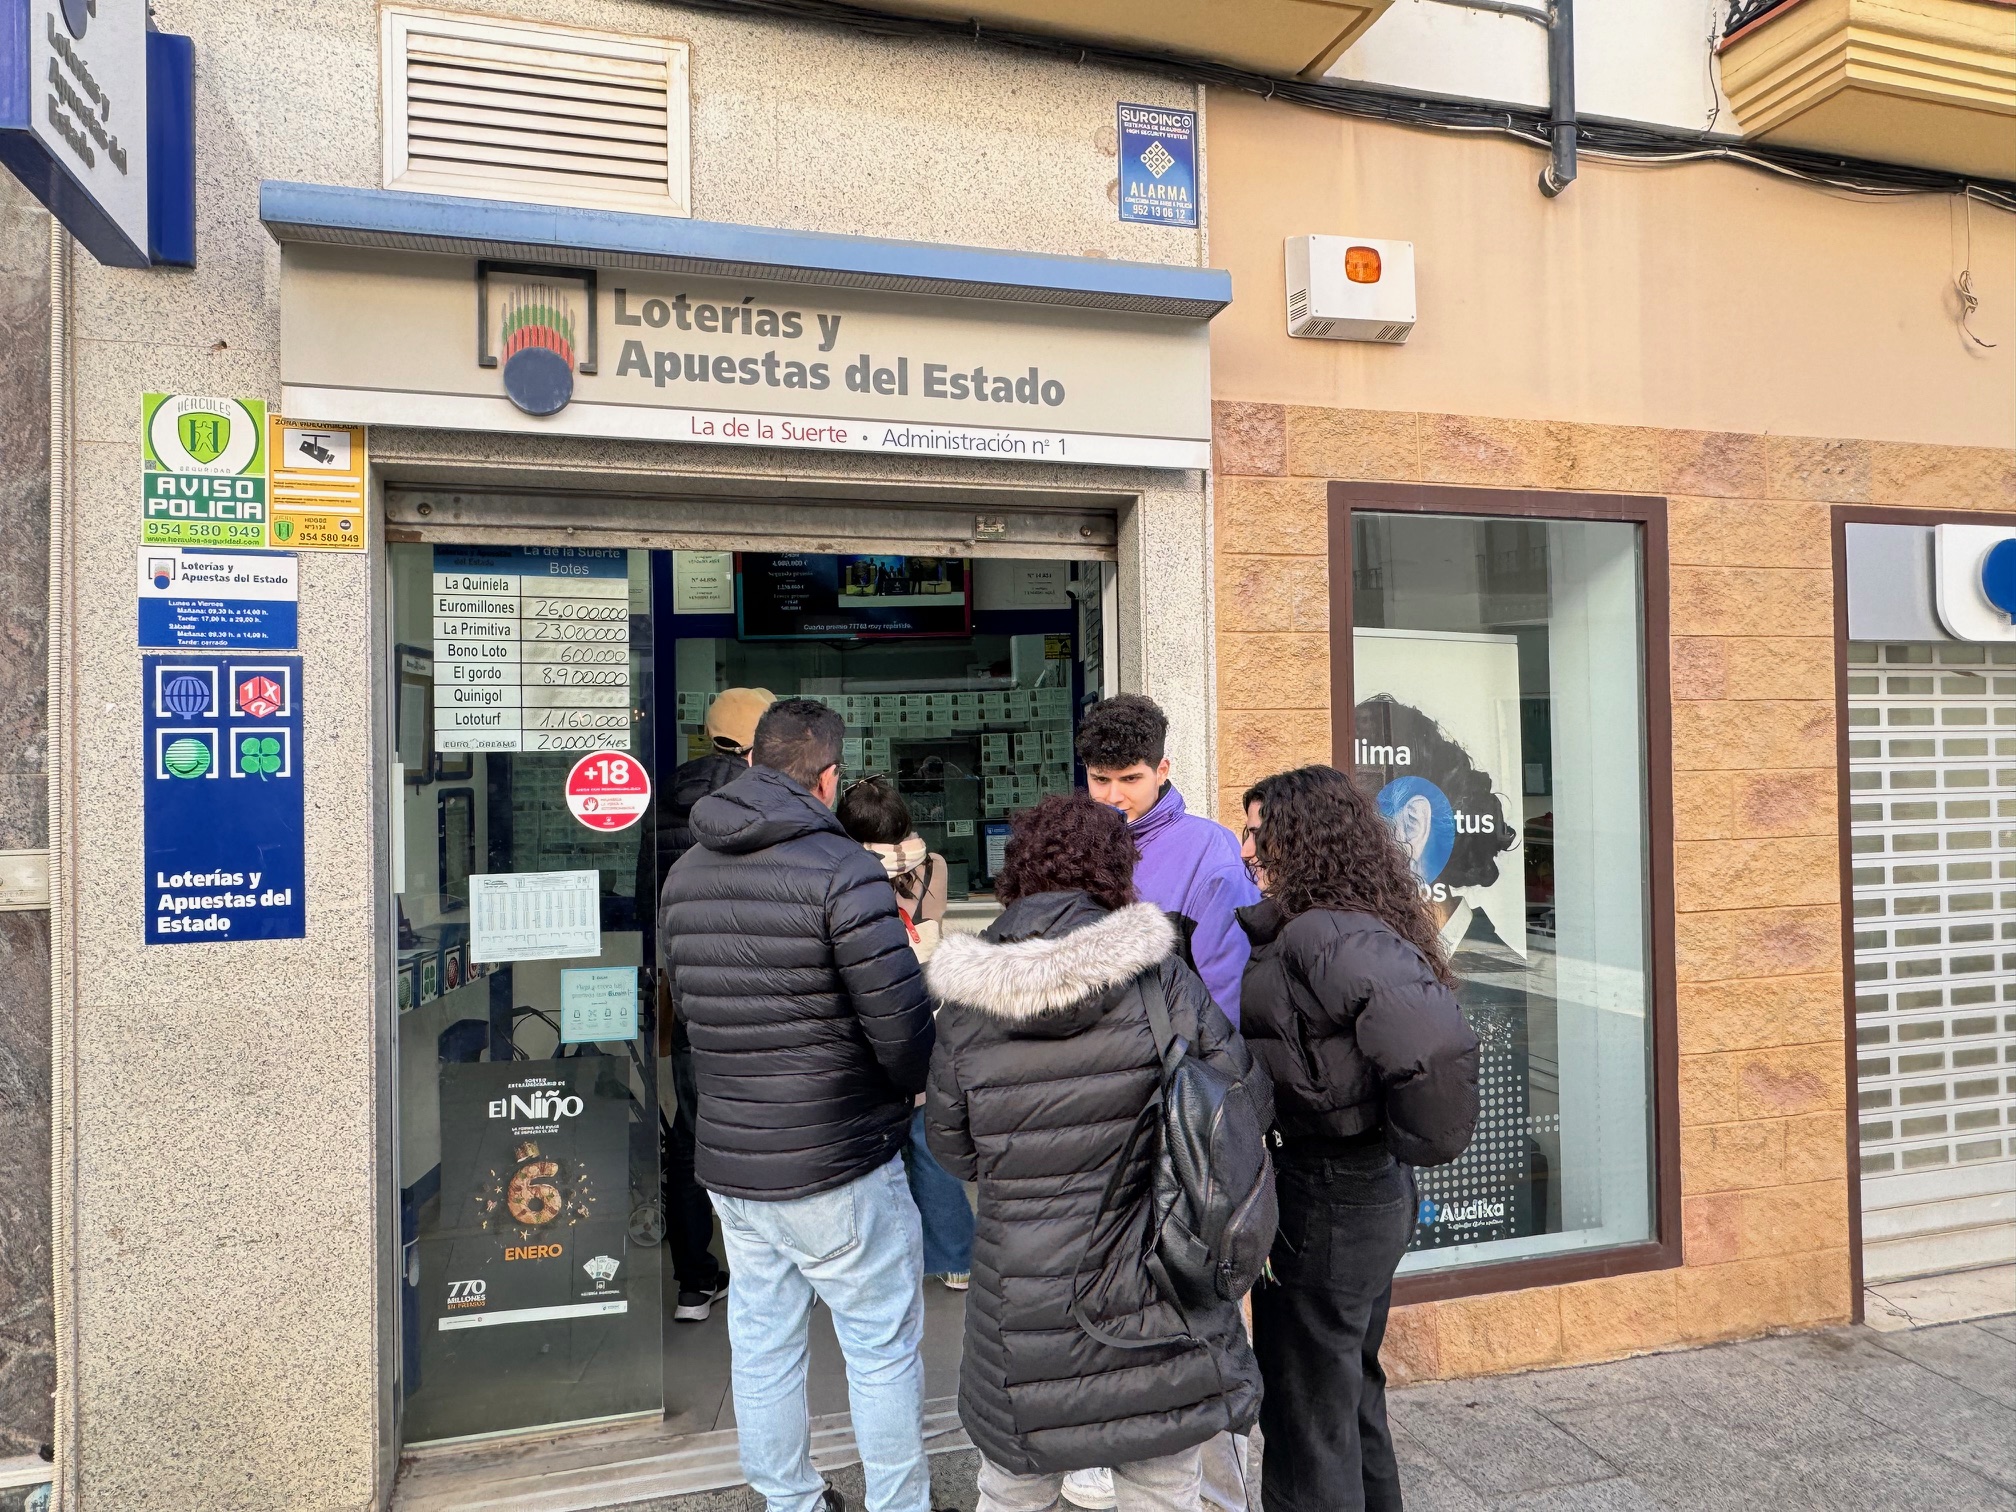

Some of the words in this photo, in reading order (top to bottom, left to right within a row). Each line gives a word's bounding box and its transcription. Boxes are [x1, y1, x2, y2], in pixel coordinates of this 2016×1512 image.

[1121, 109, 1191, 128] SUROINCO
[1130, 181, 1188, 202] ALARMA
[1132, 204, 1149, 216] 952
[1151, 206, 1161, 217] 13
[1176, 209, 1186, 219] 12
[614, 288, 803, 339] Loterías
[818, 313, 842, 352] y
[616, 339, 831, 390] Apuestas
[845, 356, 909, 396] del
[922, 364, 1066, 407] Estado
[690, 415, 716, 437] La
[722, 416, 750, 439] de
[756, 417, 775, 440] la
[781, 419, 849, 444] Suerte
[882, 427, 1027, 455] Administración
[1058, 438, 1067, 456] 1
[179, 465, 231, 474] SEGURIDAD
[157, 477, 254, 499] AVISO
[148, 498, 263, 520] POLICIA
[149, 522, 181, 535] 954
[189, 524, 221, 537] 580
[228, 526, 260, 538] 949
[299, 532, 318, 541] 954
[320, 533, 339, 542] 580
[341, 534, 359, 542] 949
[524, 547, 540, 556] La
[543, 547, 559, 557] de
[578, 548, 621, 559] Suerte
[181, 561, 226, 572] Loterías
[228, 564, 234, 572] y
[550, 562, 590, 575] Botes
[182, 573, 232, 584] Apuestas
[234, 574, 251, 583] del
[253, 575, 288, 584] Estado
[445, 578, 458, 590] La
[462, 577, 509, 592] Quiniela
[439, 599, 515, 614] Euromillones
[443, 622, 457, 635] La
[461, 622, 511, 636] Primitiva
[448, 643, 479, 657] Bono
[481, 644, 507, 658] Loto
[453, 666, 465, 679] El
[468, 666, 502, 682] gordo
[244, 682, 252, 699] 1
[263, 681, 277, 703] X
[454, 688, 502, 705] Quinigol
[250, 702, 275, 716] 2
[455, 712, 501, 726] Lototurf
[584, 760, 630, 785] +18
[1453, 809, 1495, 835] tus
[157, 868, 244, 889] Loterías
[249, 871, 262, 889] y
[157, 891, 257, 914] Apuestas
[260, 888, 292, 906] del
[157, 914, 231, 933] Estado
[488, 1098, 507, 1118] El
[510, 1089, 584, 1122] Niño
[507, 1162, 562, 1225] 6
[1439, 1199, 1505, 1223] Audika
[504, 1243, 563, 1261] ENERO
[447, 1279, 487, 1297] 770
[447, 1294, 487, 1304] MILLONES
